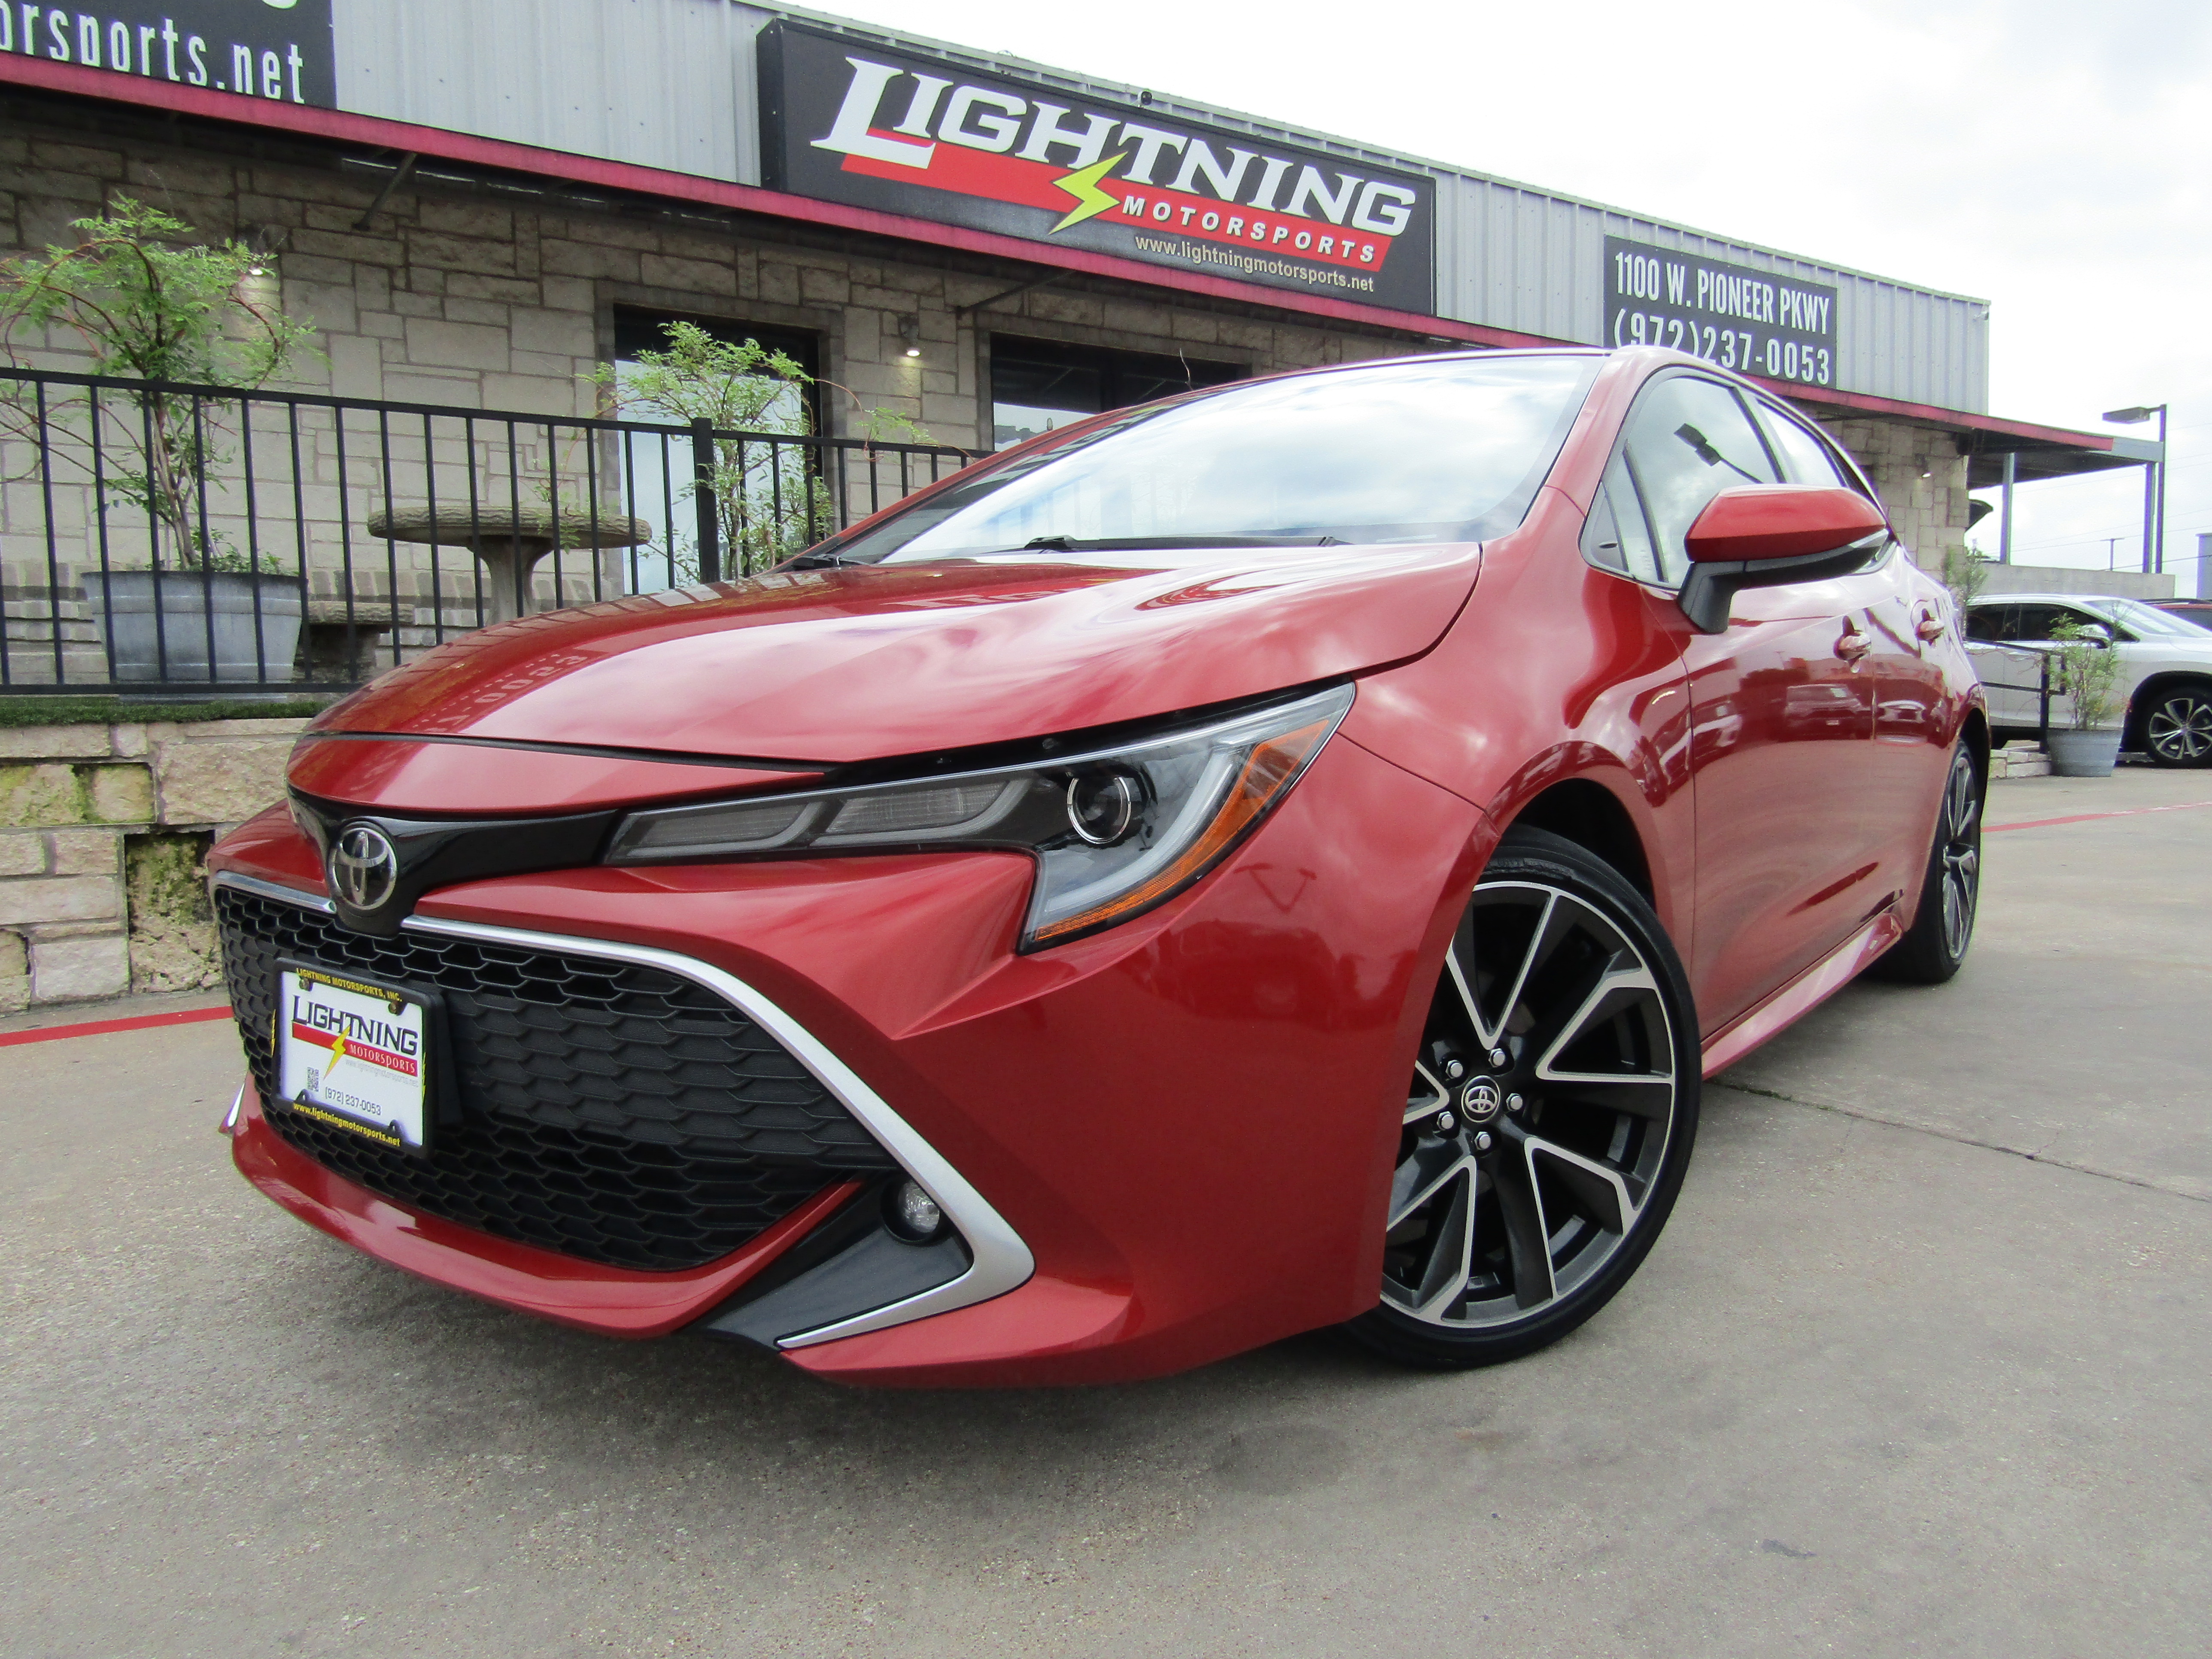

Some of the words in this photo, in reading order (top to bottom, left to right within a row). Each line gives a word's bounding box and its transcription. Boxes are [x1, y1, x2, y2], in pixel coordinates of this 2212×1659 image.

[811, 56, 1416, 236] LIGHTNING
[1122, 195, 1375, 263] MOTORSPORTS
[1135, 236, 1374, 292] www.lightningmotorsports.net
[1615, 252, 1660, 301] 1100
[1666, 261, 1691, 307] W.
[1697, 268, 1774, 324] PIONEER
[1780, 287, 1830, 335] PKWY
[296, 968, 331, 984] LIGHTNING
[387, 990, 402, 1002] INC.
[292, 995, 419, 1056] LIGHTNING
[349, 1043, 416, 1073] MOTORSPORTS
[293, 1102, 401, 1147] www.lightningmotorsports.net
[325, 1086, 344, 1105] (972)
[345, 1094, 382, 1116] 237-0053
